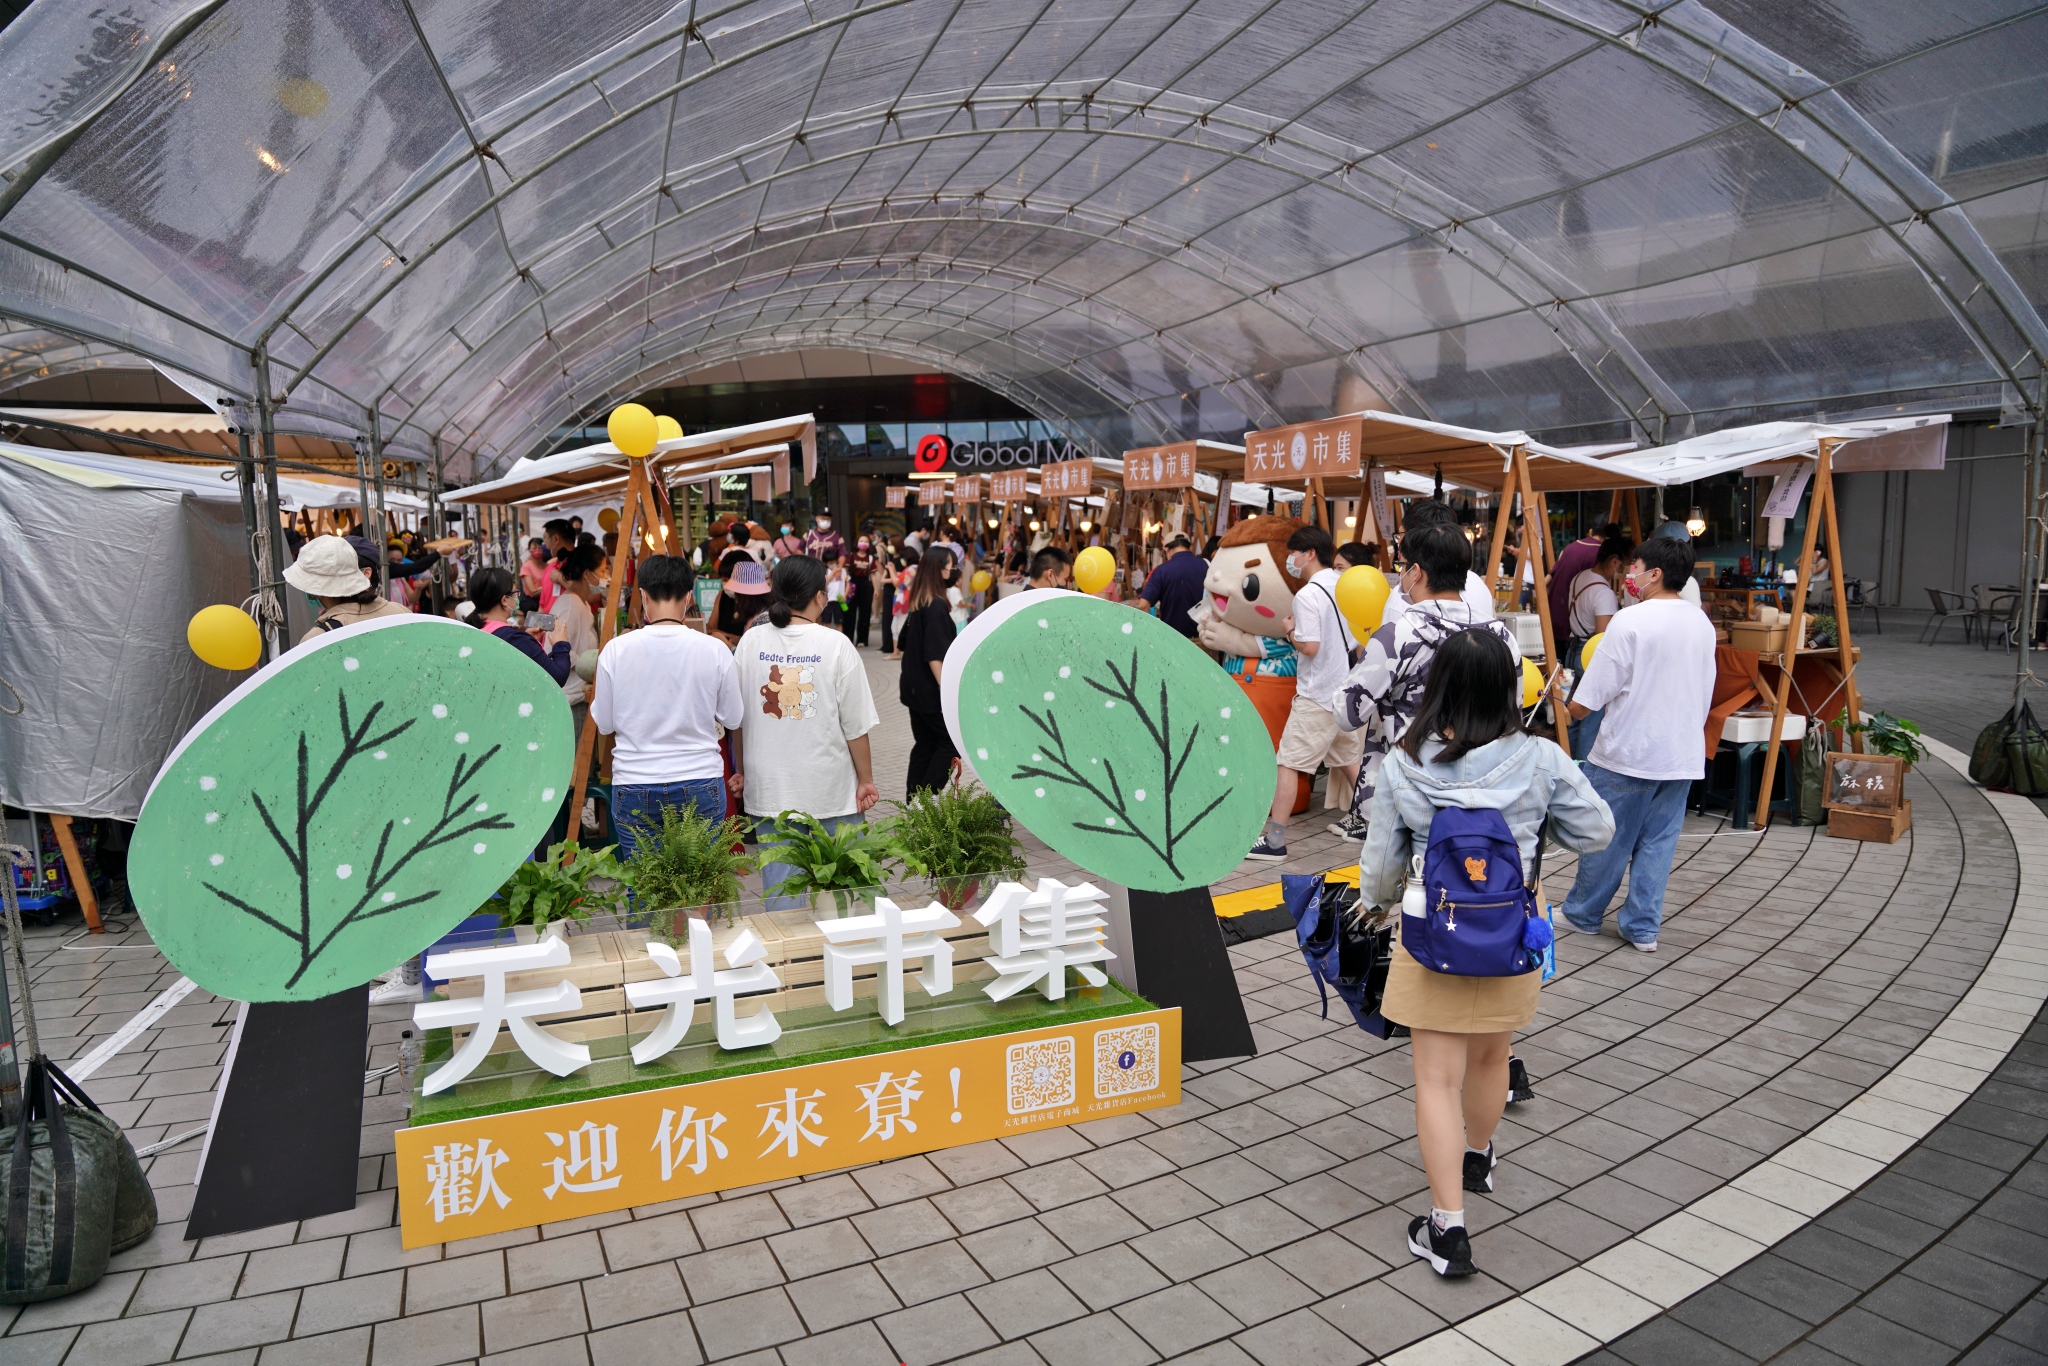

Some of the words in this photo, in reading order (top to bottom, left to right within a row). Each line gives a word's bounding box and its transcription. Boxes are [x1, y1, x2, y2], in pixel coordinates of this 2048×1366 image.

[950, 440, 1038, 467] Global
[1253, 439, 1286, 471] 天光
[1313, 431, 1352, 466] 市集
[1044, 469, 1060, 490] 天光
[1071, 466, 1088, 488] 市集
[1129, 458, 1150, 481] 天光
[1166, 452, 1190, 478] 市集
[786, 653, 822, 664] Freunde
[412, 878, 1118, 1097] 天光市集
